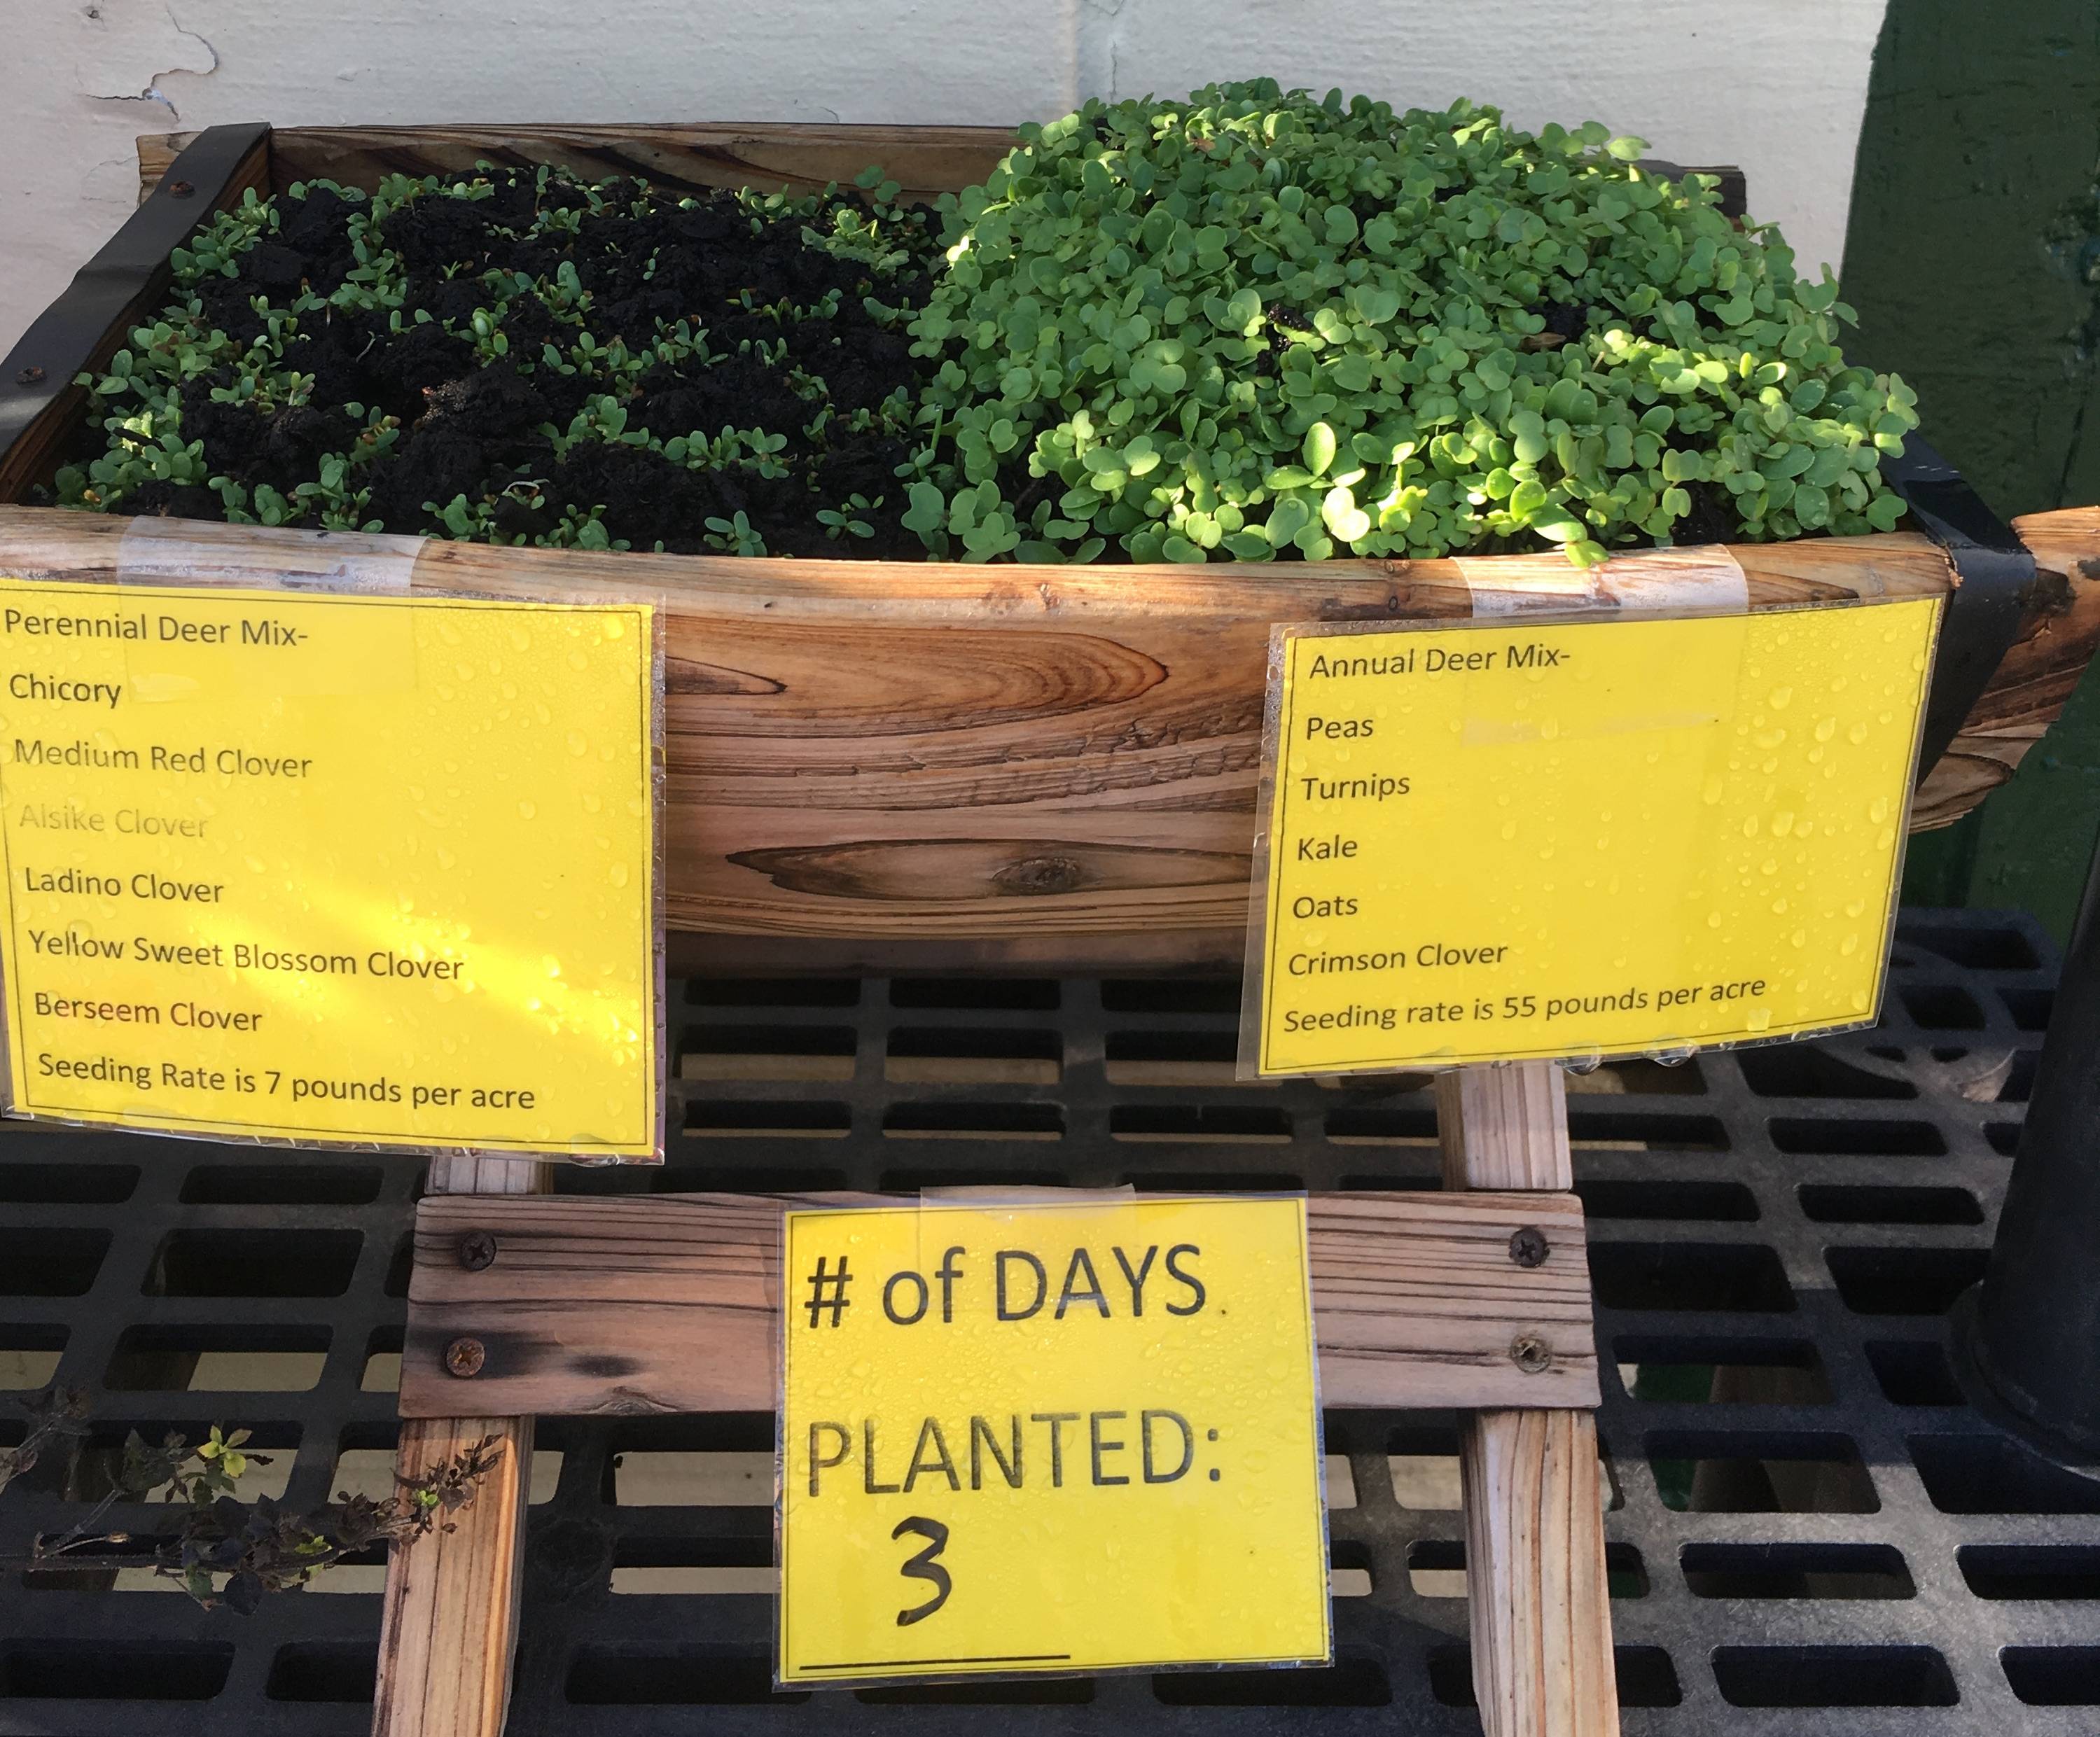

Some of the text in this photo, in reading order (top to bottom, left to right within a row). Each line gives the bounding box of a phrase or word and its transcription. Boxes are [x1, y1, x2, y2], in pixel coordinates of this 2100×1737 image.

[4, 608, 309, 647] Perennial Deer Mix-
[1309, 643, 1571, 681] Annual Deer Mix-
[9, 674, 123, 709] Chicory
[1307, 716, 1374, 741] Peas
[14, 738, 314, 779] Medium Red Clover
[1301, 772, 1410, 803] Turnips
[18, 804, 209, 839] Alsike Clover
[1298, 836, 1358, 862] Kale
[25, 867, 225, 904] Ladino Clover
[1292, 895, 1358, 920] Oats
[28, 929, 465, 982] Yellow Sweet Blossom Clover
[1288, 942, 1508, 977] Crimson Clover
[34, 992, 263, 1033] Berseem Clover
[1284, 977, 1767, 1033] Seeding rate is 55 pounds per acre
[39, 1052, 536, 1110] Seeding Rate is 7 pounds per acre
[804, 1243, 1207, 1329] # of DAYS
[807, 1409, 1222, 1498] PLANTED:
[890, 1515, 953, 1627] 3
